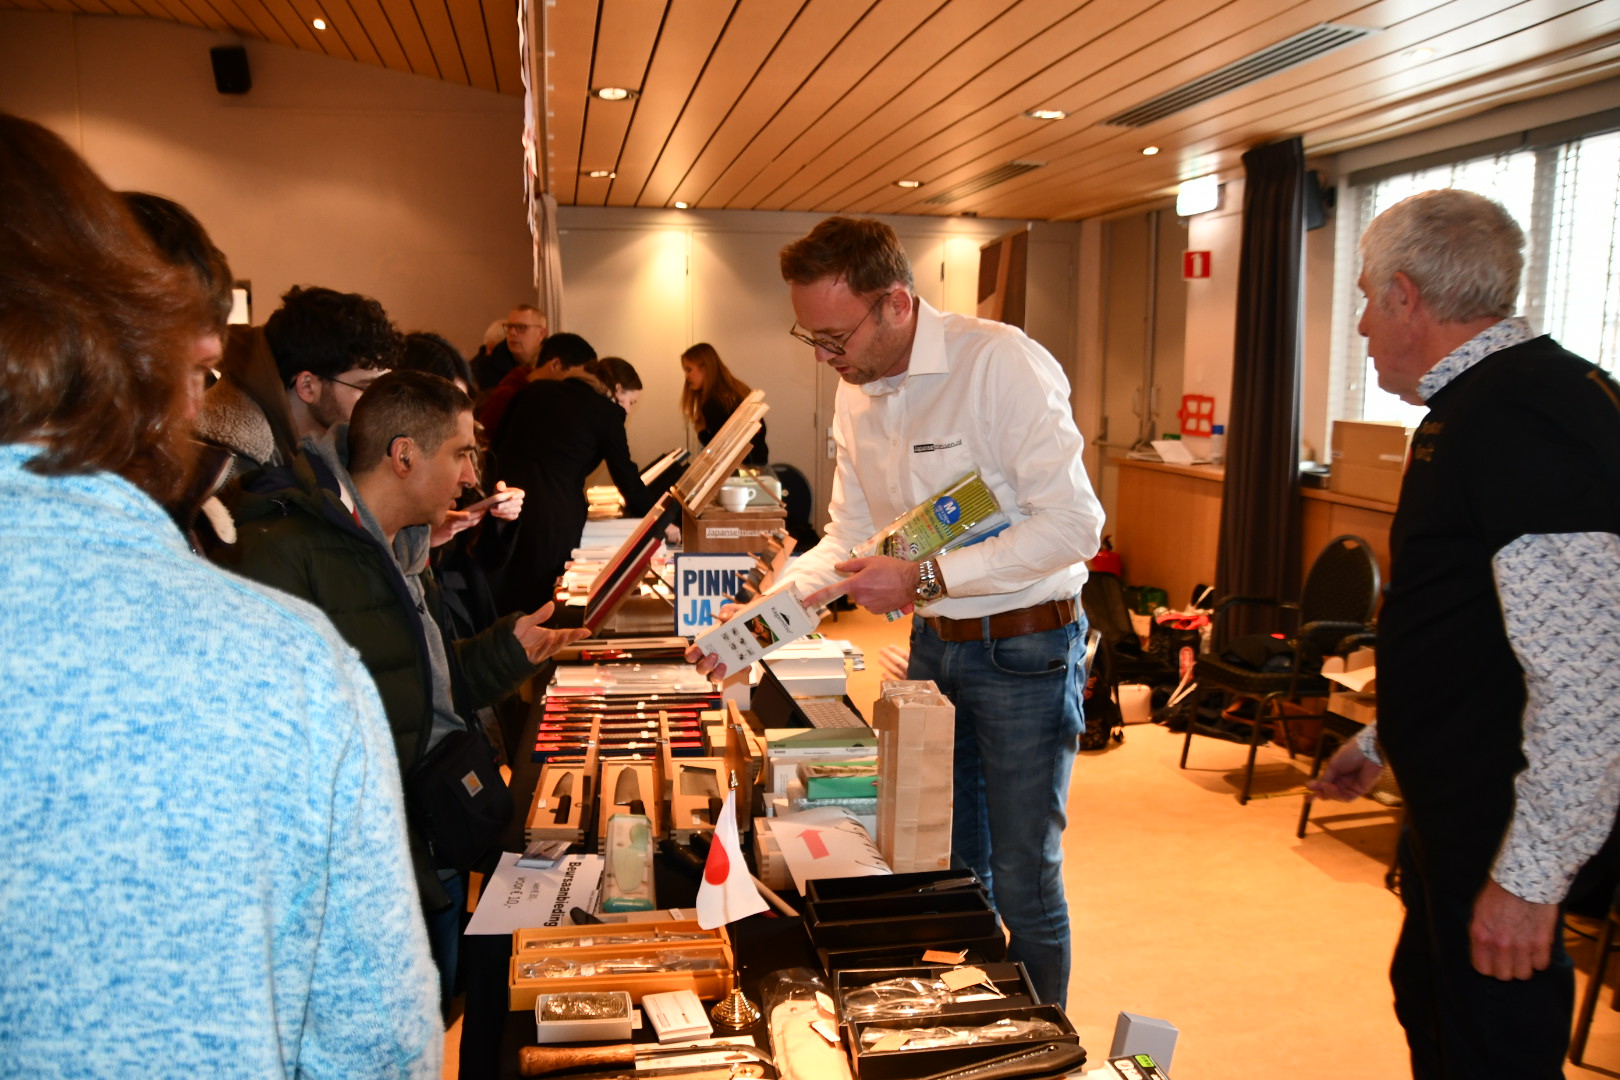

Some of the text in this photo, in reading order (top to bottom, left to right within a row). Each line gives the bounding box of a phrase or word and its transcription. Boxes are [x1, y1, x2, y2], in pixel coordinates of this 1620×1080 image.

[943, 501, 957, 514] M
[683, 599, 713, 626] JA
[513, 876, 526, 890] voor
[544, 861, 582, 927] Beursaanbieding
